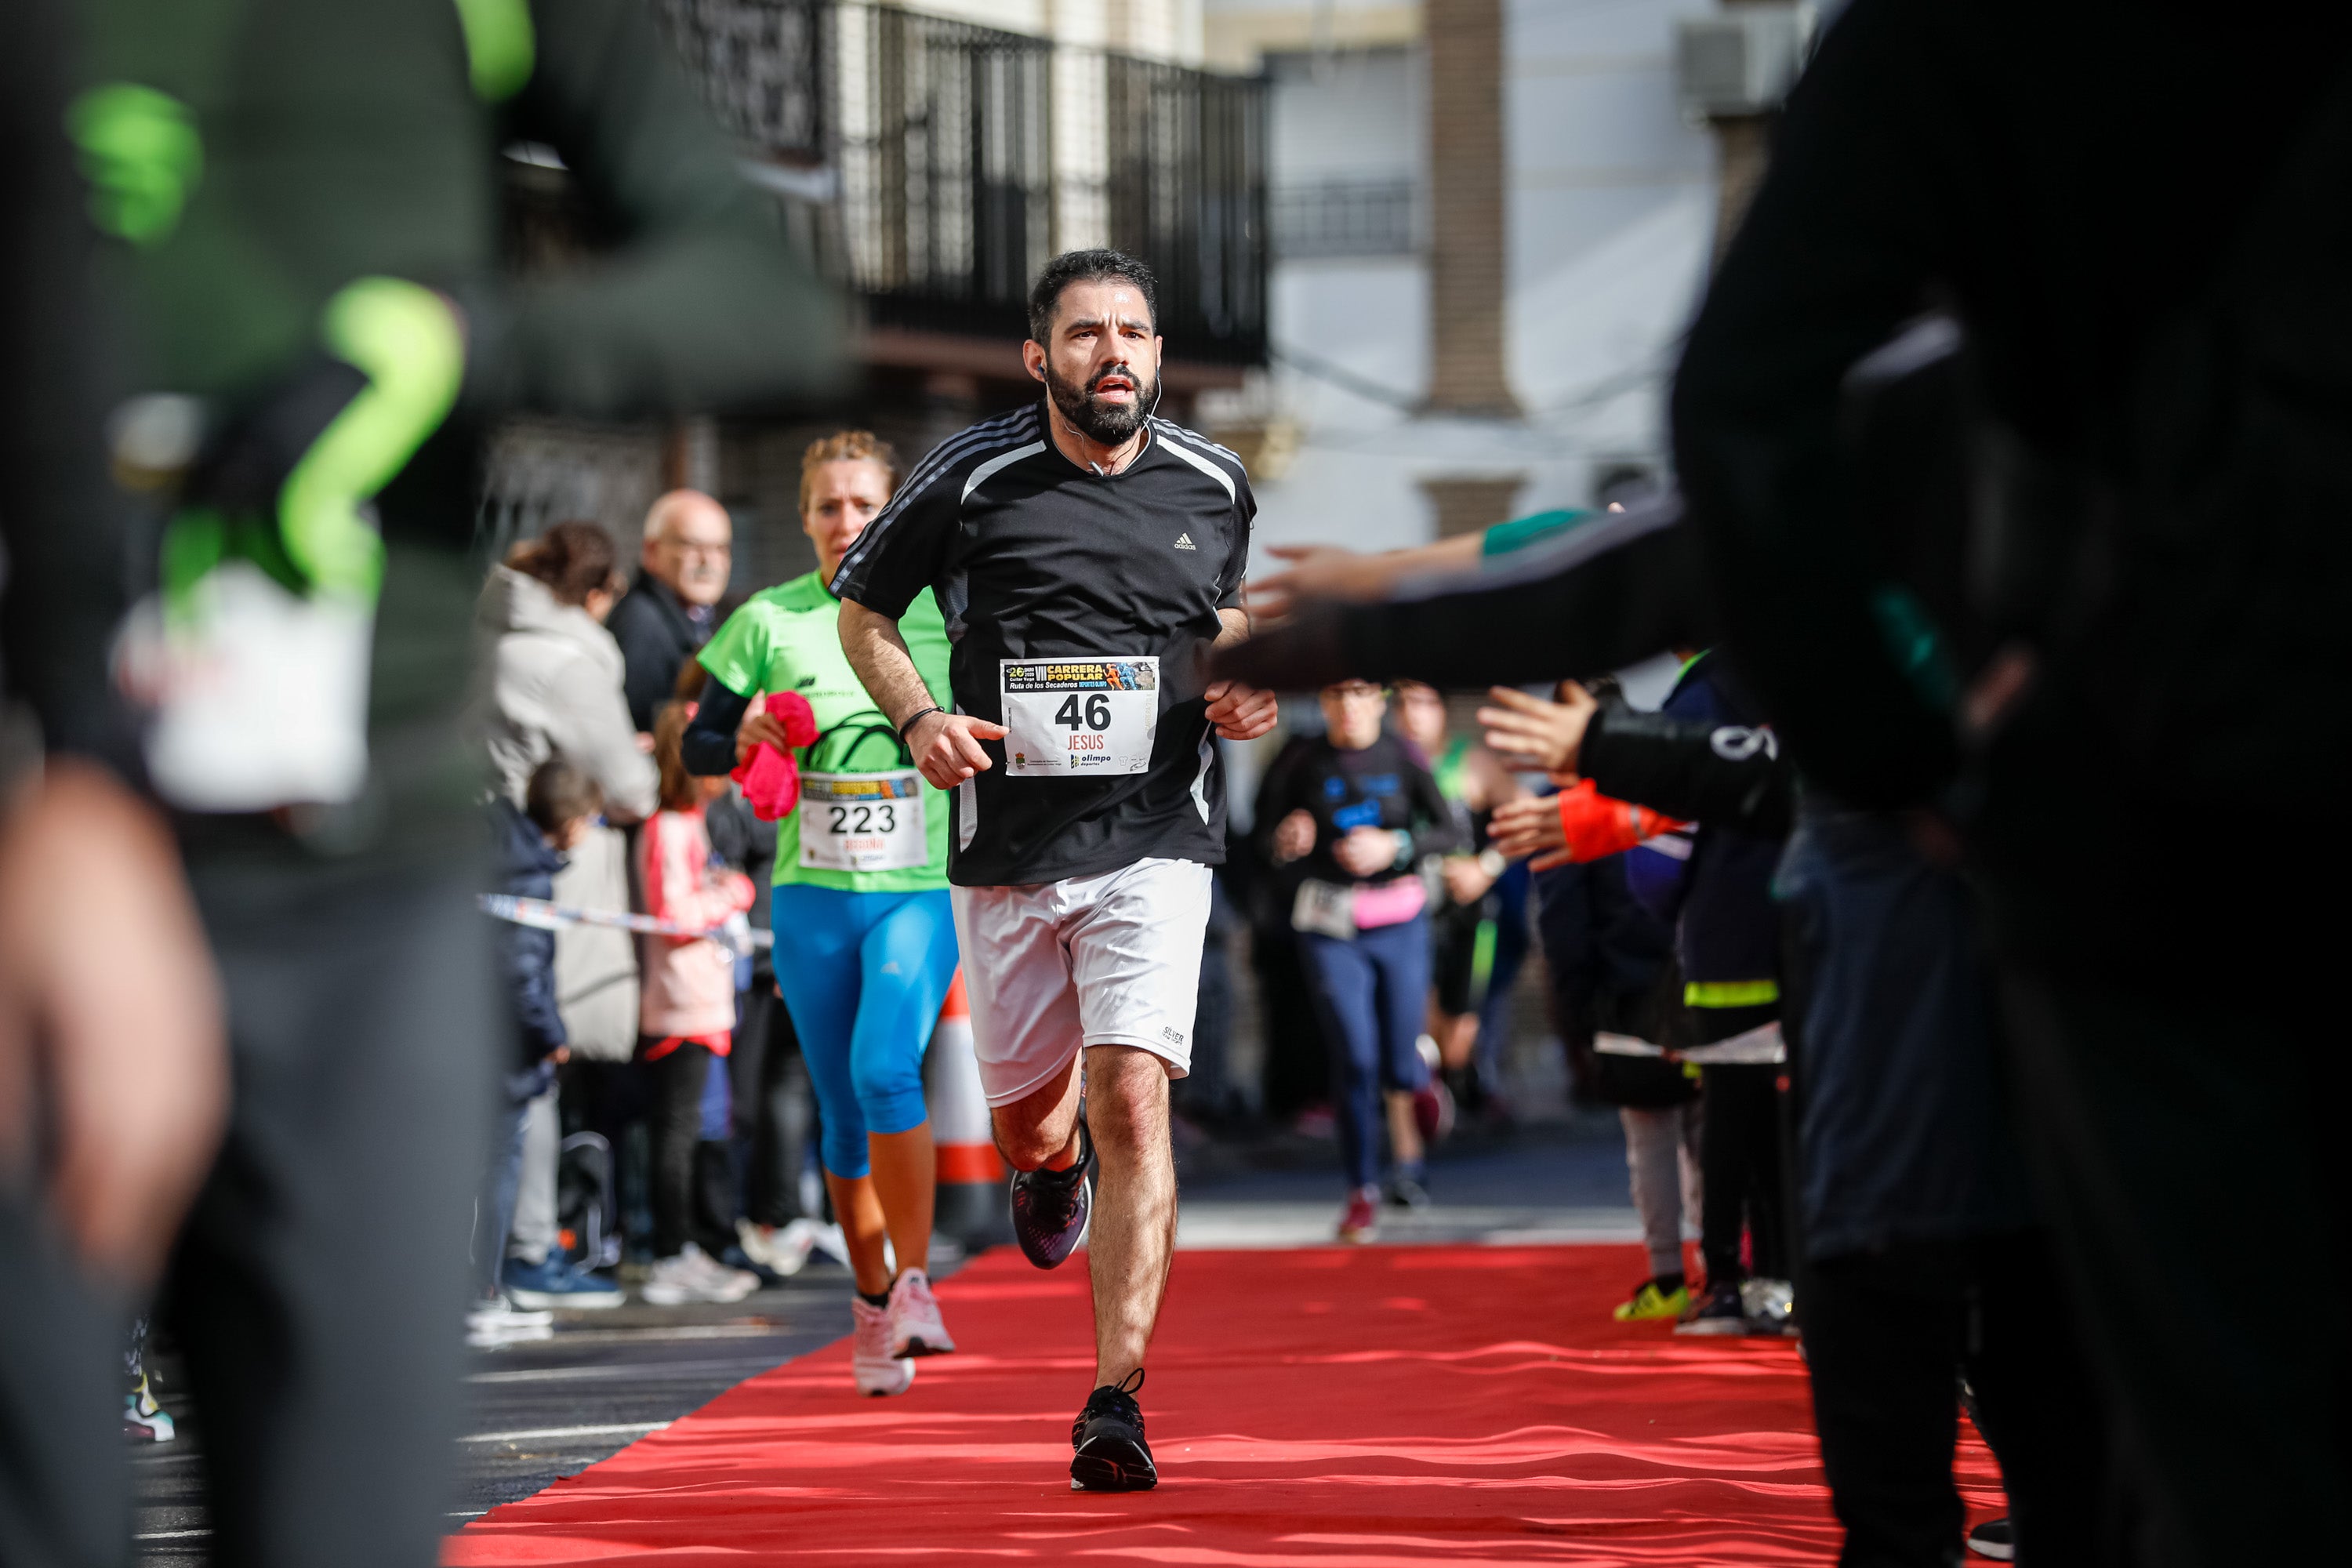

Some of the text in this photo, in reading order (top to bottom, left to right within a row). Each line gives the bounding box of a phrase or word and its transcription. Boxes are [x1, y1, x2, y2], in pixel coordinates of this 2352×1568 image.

[1009, 667, 1025, 677] 26
[1035, 665, 1103, 681] VII CARRERA
[1055, 693, 1111, 731] 46
[1067, 735, 1104, 750] JESUS
[829, 805, 895, 833] 223
[1163, 1026, 1184, 1042] SILVER
